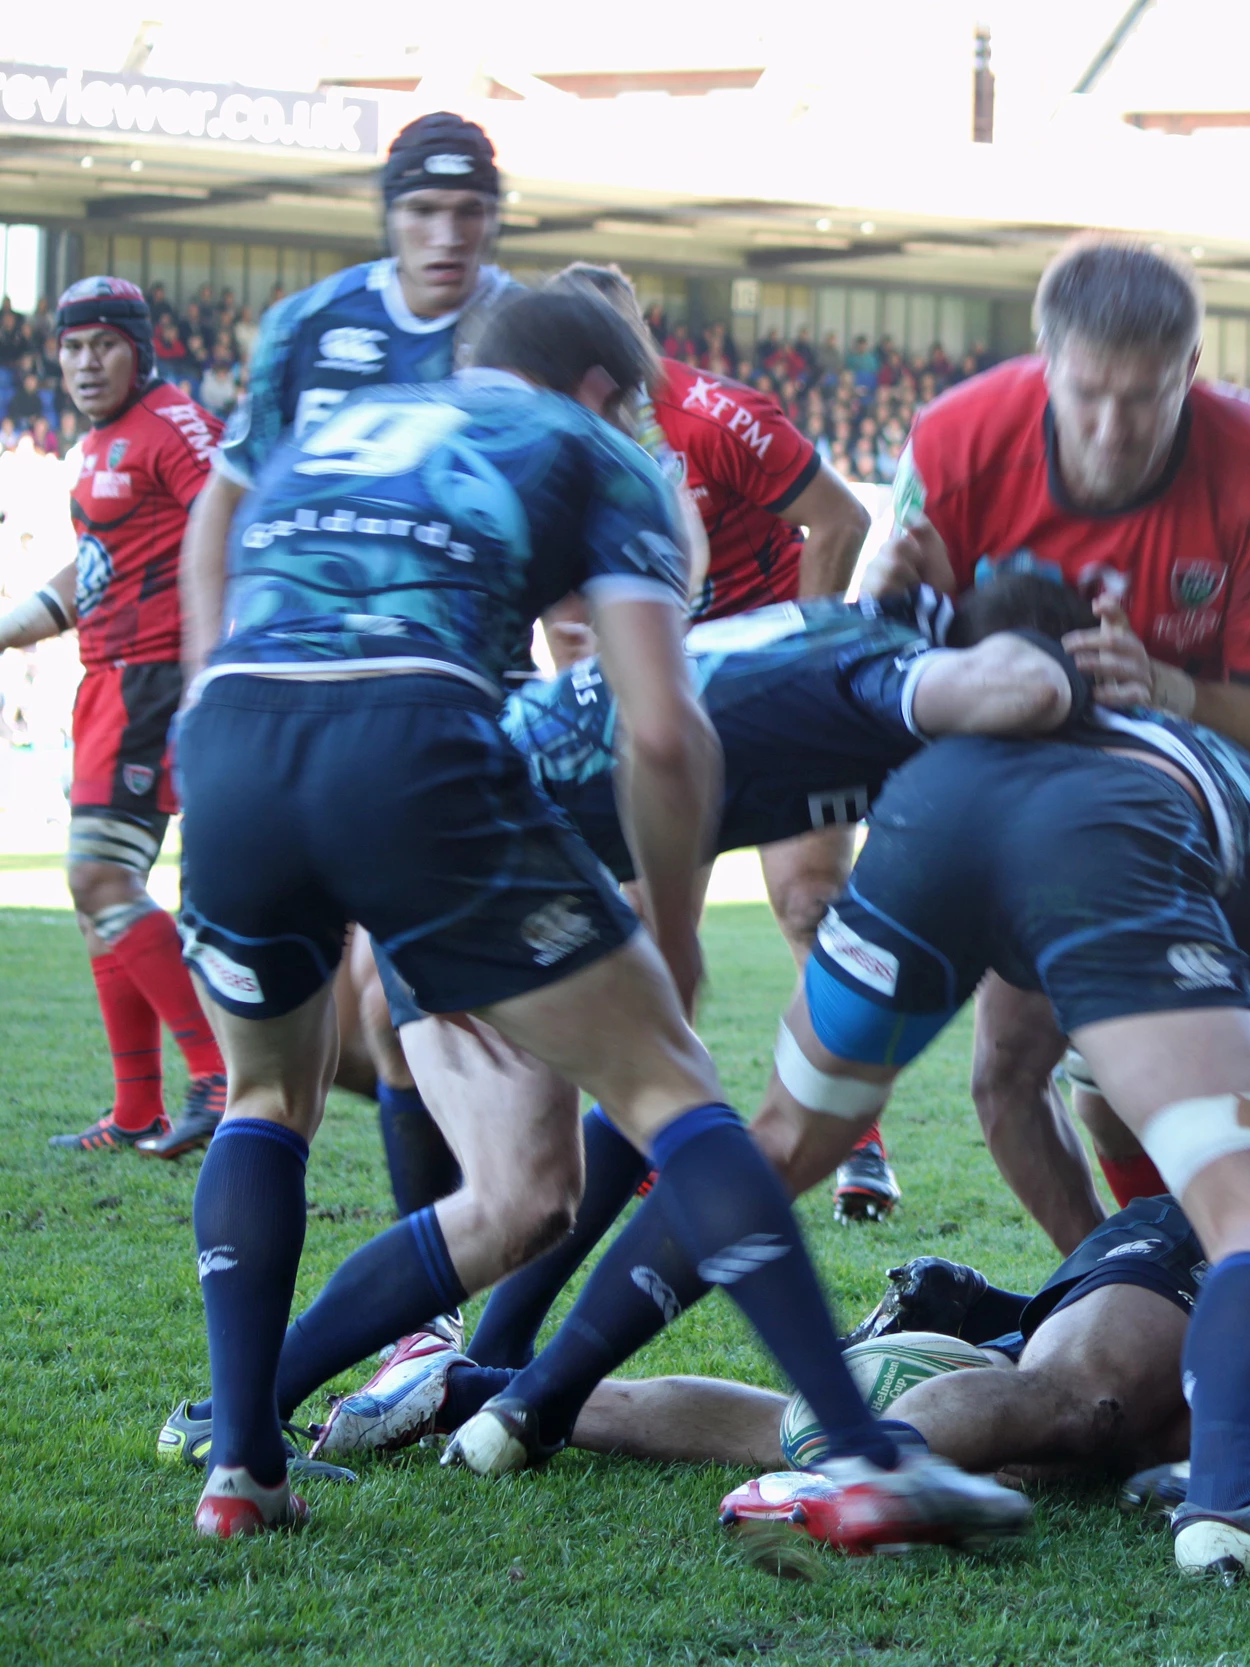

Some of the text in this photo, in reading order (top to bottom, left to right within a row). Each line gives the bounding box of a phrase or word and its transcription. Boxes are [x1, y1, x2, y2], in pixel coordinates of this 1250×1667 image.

[711, 392, 774, 460] TPM
[870, 1361, 900, 1411] Heineken
[889, 1378, 908, 1399] Cup
